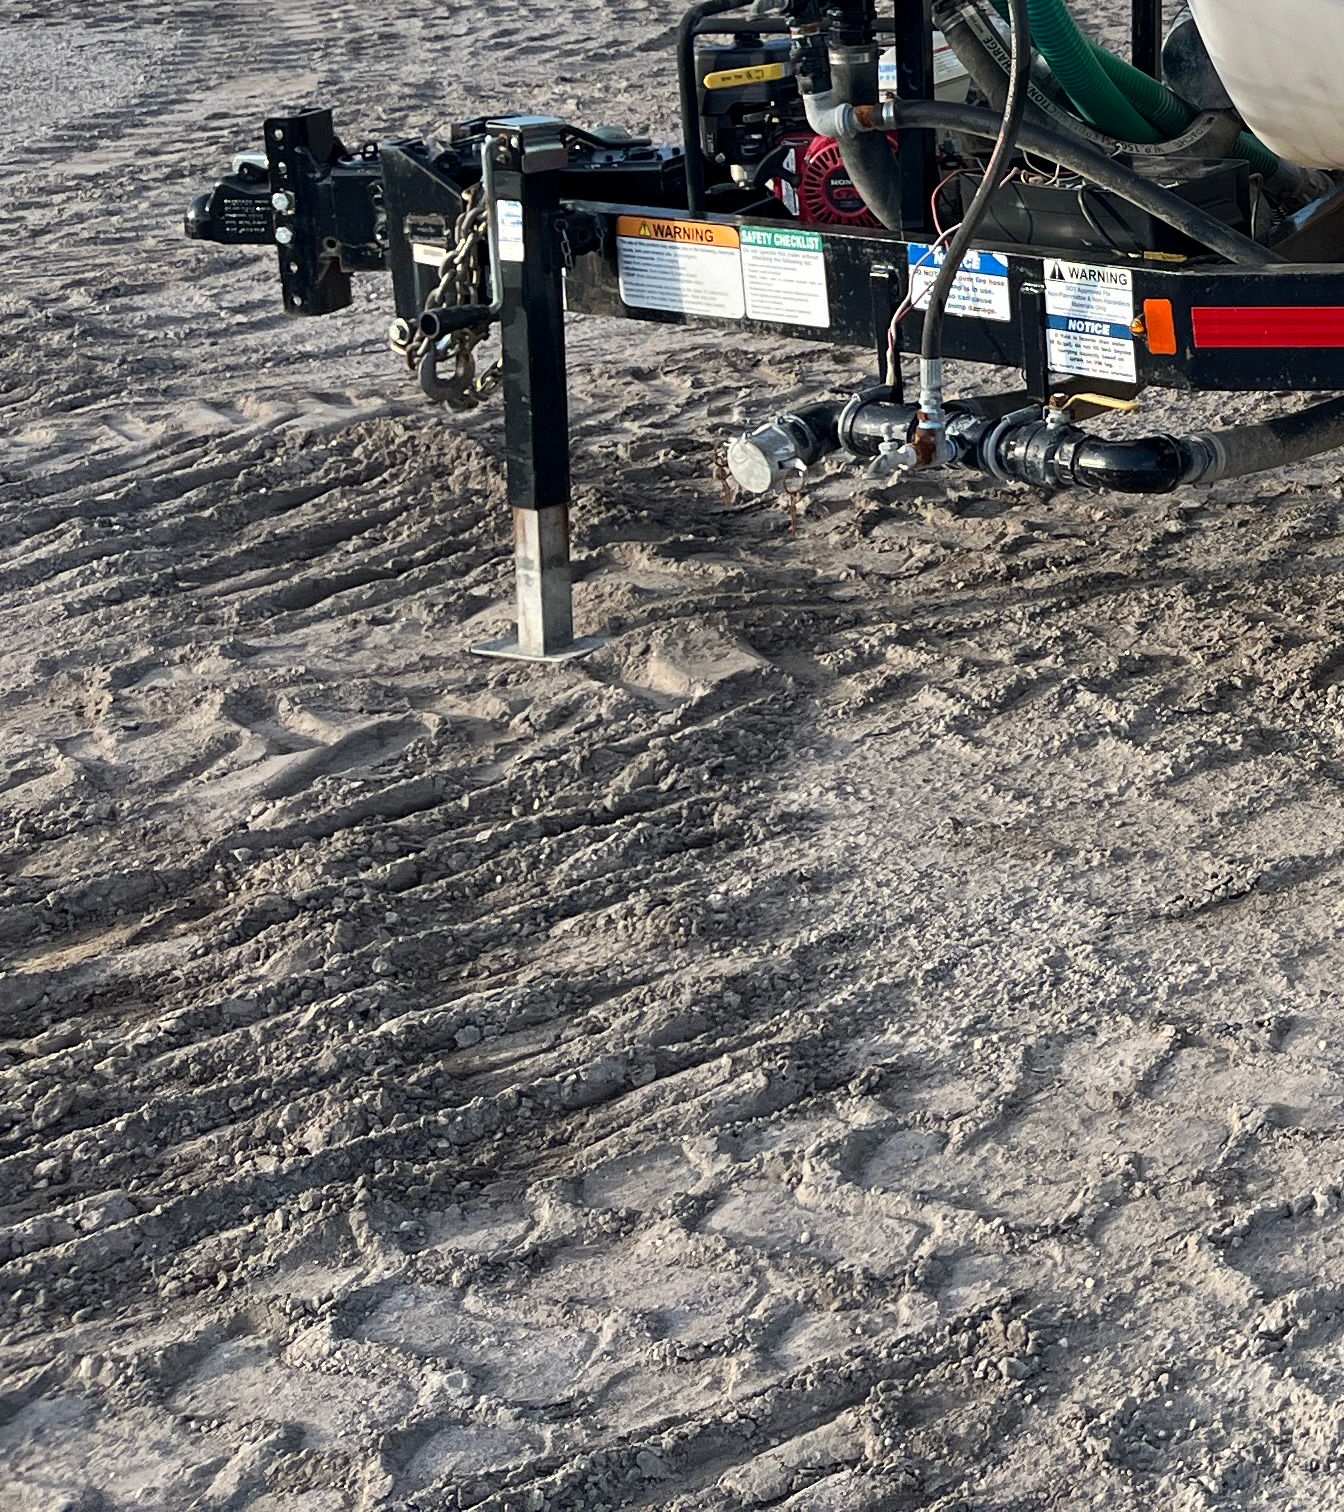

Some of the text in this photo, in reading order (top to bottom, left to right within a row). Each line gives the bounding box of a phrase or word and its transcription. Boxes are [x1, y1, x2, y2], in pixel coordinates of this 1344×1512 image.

[652, 222, 714, 243] WARNING
[741, 229, 820, 250] SAFETY CHECKLIST
[1068, 266, 1128, 286] WARNING
[1068, 319, 1111, 336] NOTICE
